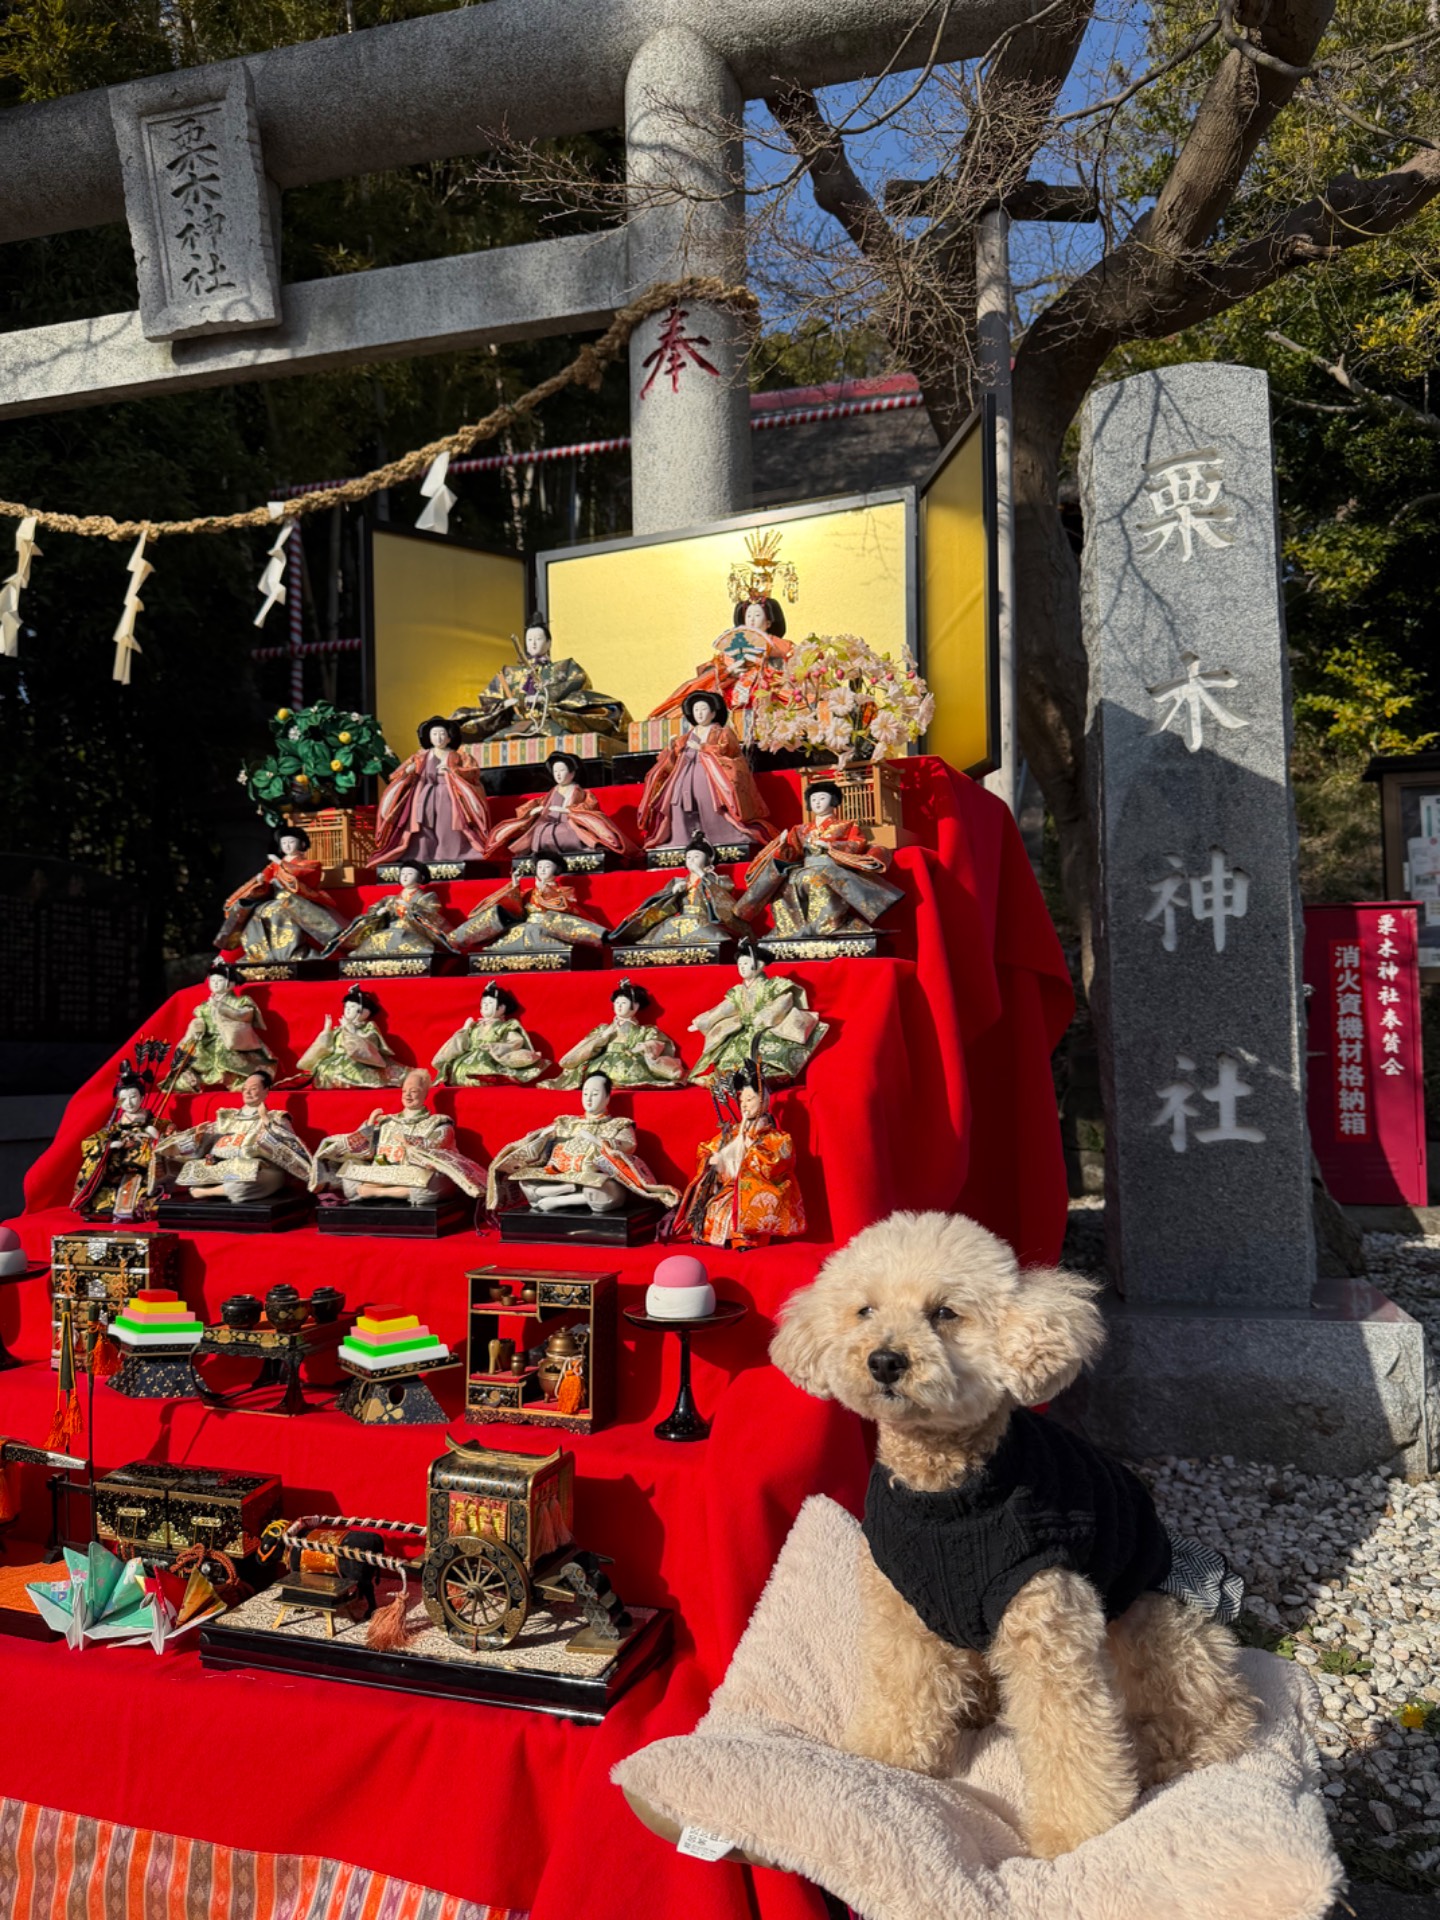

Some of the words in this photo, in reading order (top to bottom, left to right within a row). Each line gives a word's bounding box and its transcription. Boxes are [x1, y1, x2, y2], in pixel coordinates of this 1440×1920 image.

[166, 117, 236, 296] 栗木神社
[640, 306, 721, 400] 奉
[1136, 446, 1267, 1153] 栗木神社
[1334, 945, 1367, 1135] 消火資機材格納箱
[1377, 913, 1405, 1076] 栗木神社奉賛会
